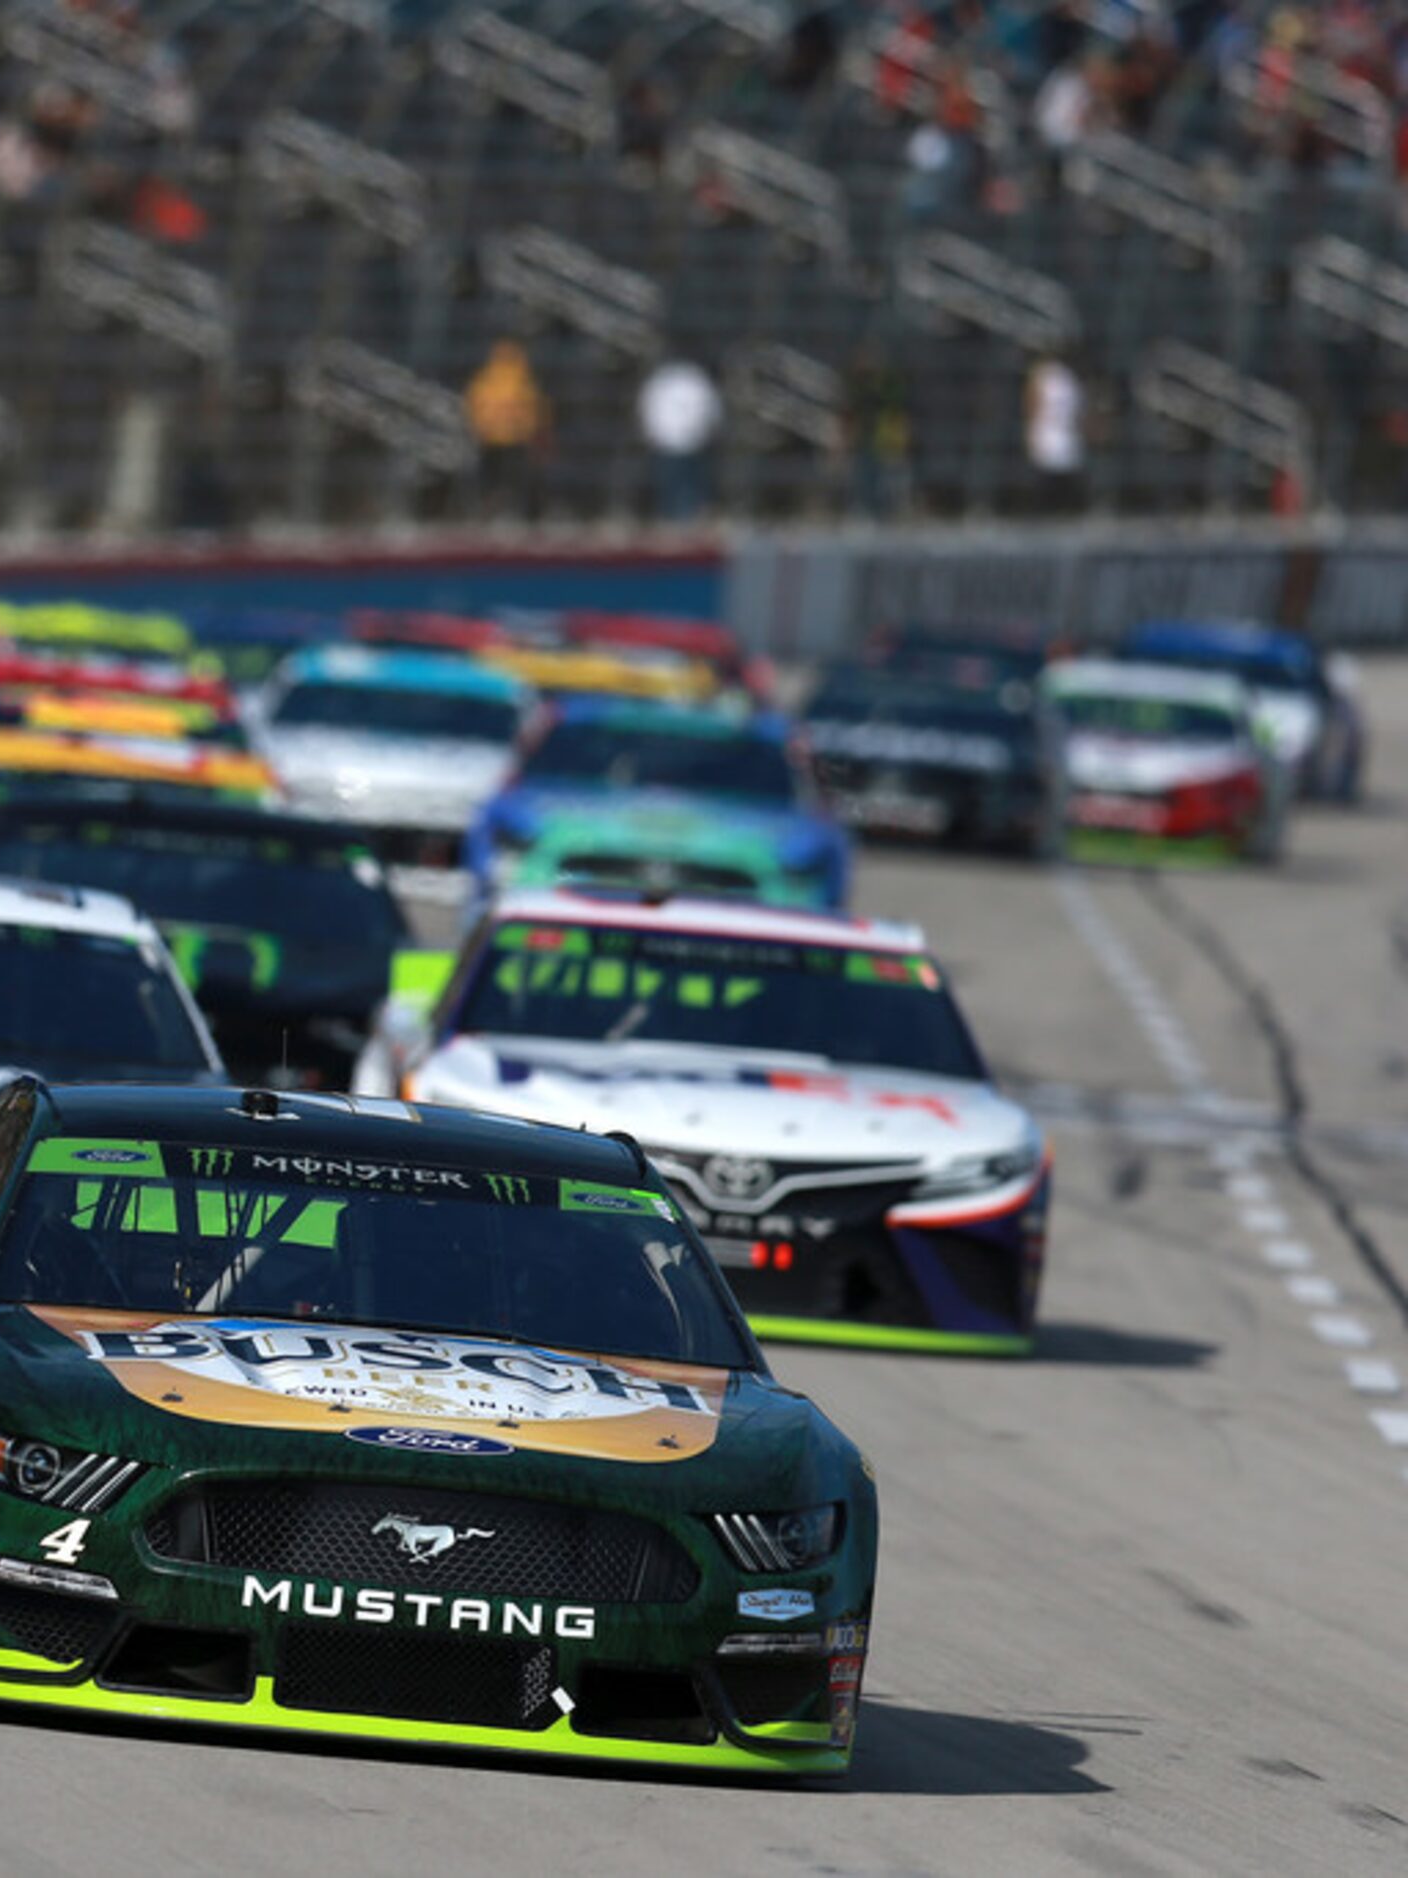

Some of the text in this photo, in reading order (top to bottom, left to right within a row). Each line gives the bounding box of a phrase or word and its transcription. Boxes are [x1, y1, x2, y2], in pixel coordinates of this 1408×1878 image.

[85, 1149, 138, 1162] Ford
[253, 1154, 471, 1189] MONSTER
[74, 1330, 720, 1417] BUSCH
[377, 1427, 481, 1451] Ford
[39, 1517, 92, 1565] 4
[241, 1574, 597, 1639] MUSTANG
